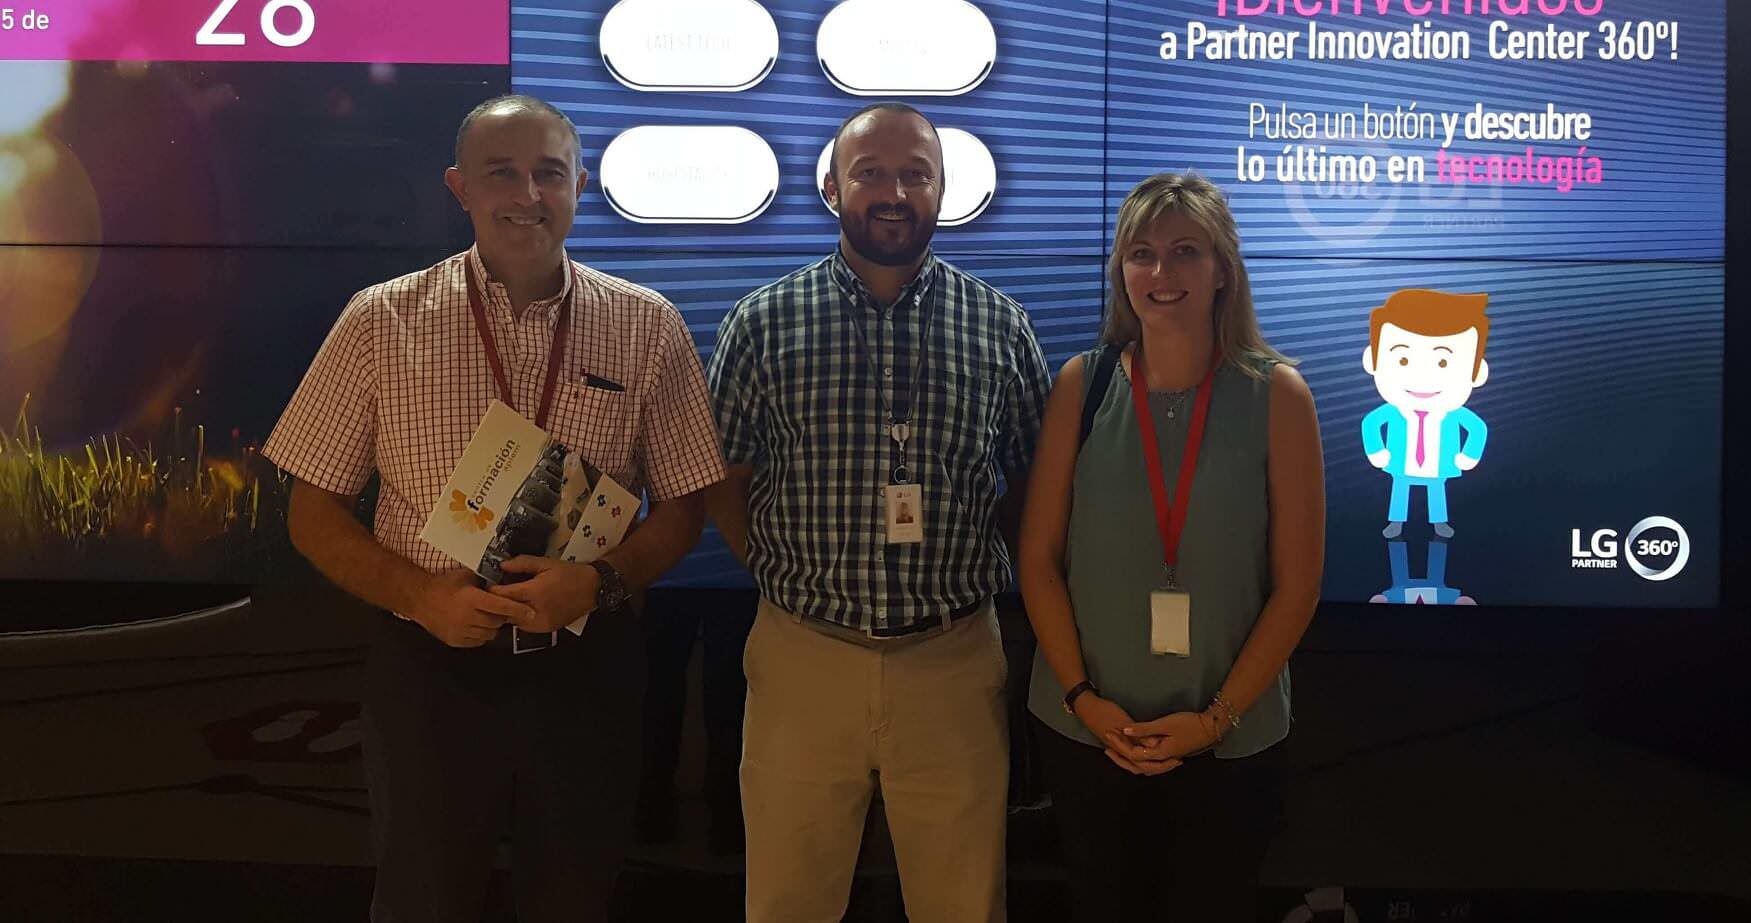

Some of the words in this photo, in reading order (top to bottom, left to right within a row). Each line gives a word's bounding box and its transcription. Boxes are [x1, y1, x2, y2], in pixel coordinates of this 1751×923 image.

[2, 9, 14, 30] 5
[22, 8, 49, 30] de
[1159, 31, 1177, 60] a
[1187, 21, 1299, 60] Partner
[1308, 21, 1470, 60] Innovation
[1488, 20, 1590, 60] Center
[1249, 102, 1317, 139] Pulsa
[1324, 112, 1356, 139] un
[1364, 102, 1436, 139] botón
[1440, 112, 1459, 148] y
[1464, 102, 1592, 140] descubre
[1237, 145, 1265, 182] lo
[1276, 144, 1377, 182] último
[1387, 155, 1425, 182] en
[1435, 145, 1603, 193] tecnología
[467, 439, 516, 511] formación
[1571, 528, 1618, 558] LG
[1571, 559, 1618, 568] PARTNER
